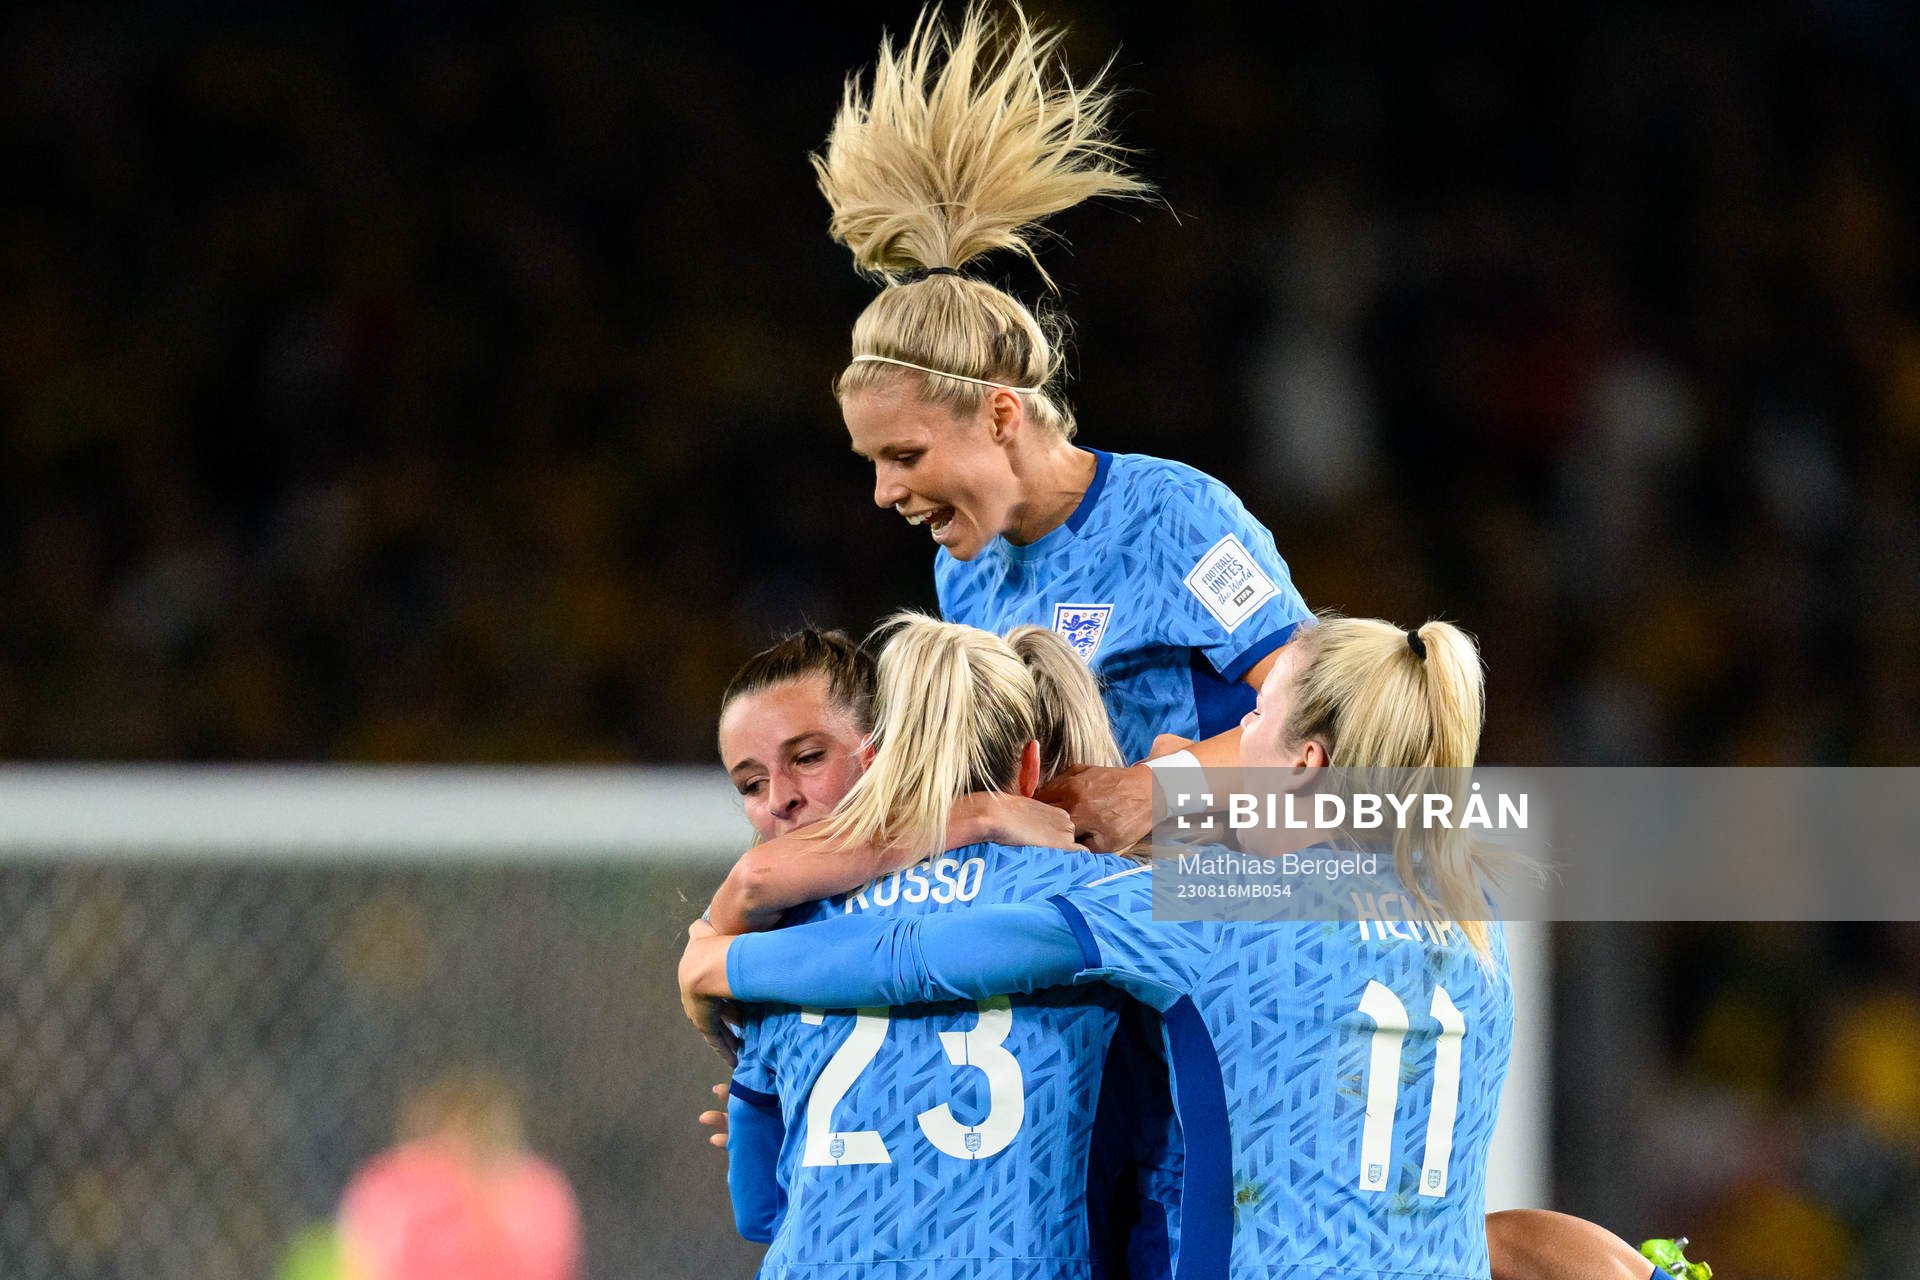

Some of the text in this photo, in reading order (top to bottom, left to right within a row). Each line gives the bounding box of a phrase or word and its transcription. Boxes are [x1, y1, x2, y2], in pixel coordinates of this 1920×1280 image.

[1202, 552, 1234, 586] FOOTBALL
[1208, 560, 1244, 595] UNITES
[801, 995, 1026, 1168] 23
[1358, 979, 1466, 1199] 11
